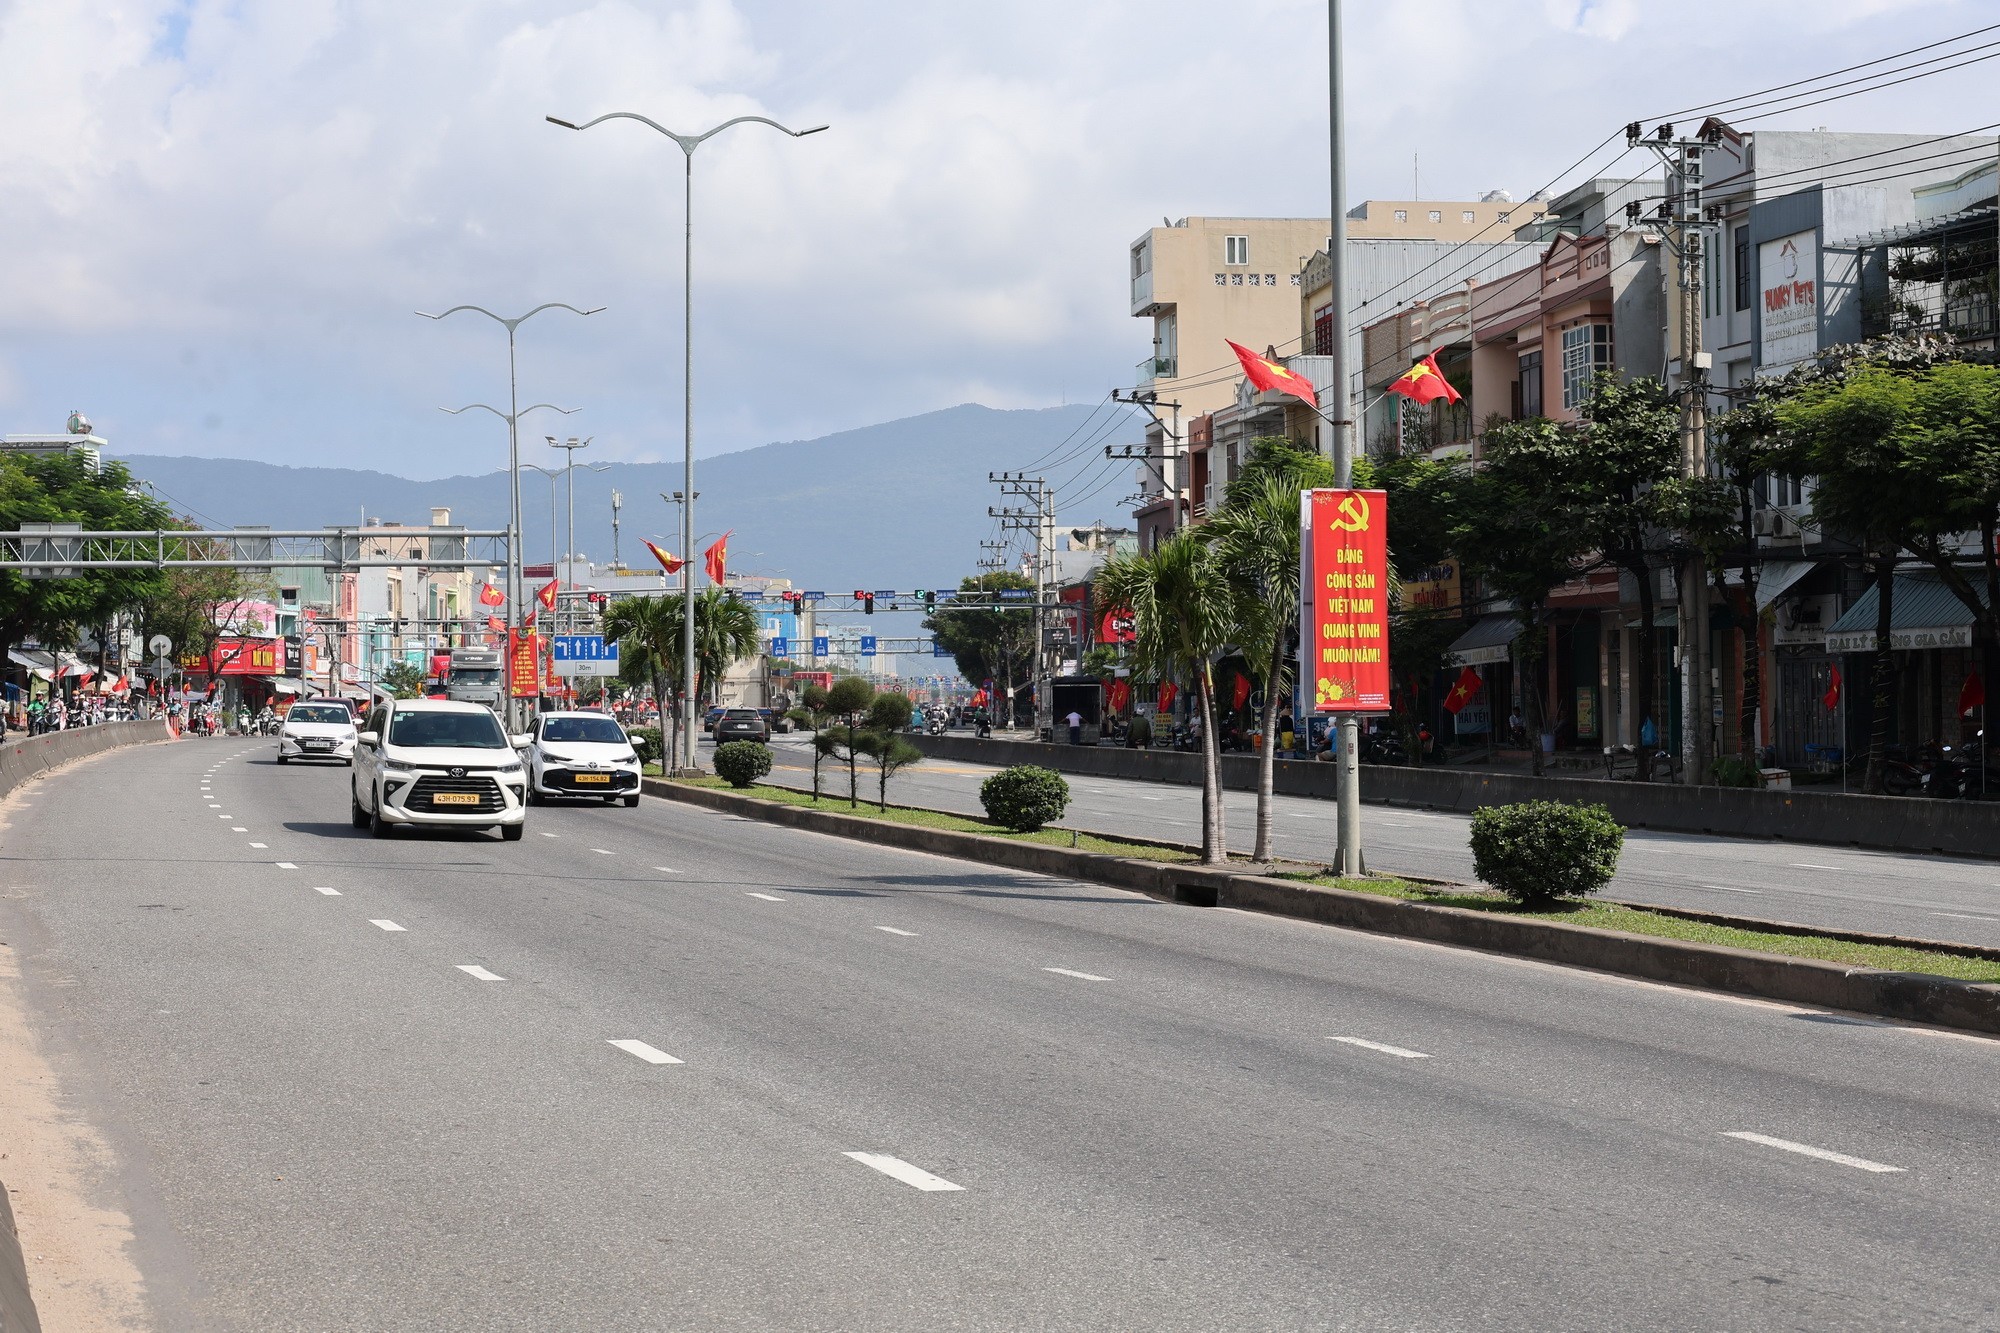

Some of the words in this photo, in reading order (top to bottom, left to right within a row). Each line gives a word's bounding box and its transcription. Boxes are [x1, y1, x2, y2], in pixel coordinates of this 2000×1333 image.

[1793, 280, 1815, 306] PETS
[1336, 543, 1363, 564] ĐẢNG
[1326, 570, 1352, 592] CỘNG
[1354, 569, 1375, 589] SẢN
[917, 590, 924, 599] 12
[1328, 595, 1349, 616] VIỆT
[1351, 598, 1374, 613] NAM
[1322, 623, 1354, 640] QUANG
[1357, 623, 1380, 638] VINH
[1853, 633, 1868, 648] LÝ
[1914, 633, 1937, 646] GIA
[1322, 645, 1353, 663] MUÔN
[1354, 645, 1380, 663] NĂM!
[437, 794, 476, 803] 43H-075.93
